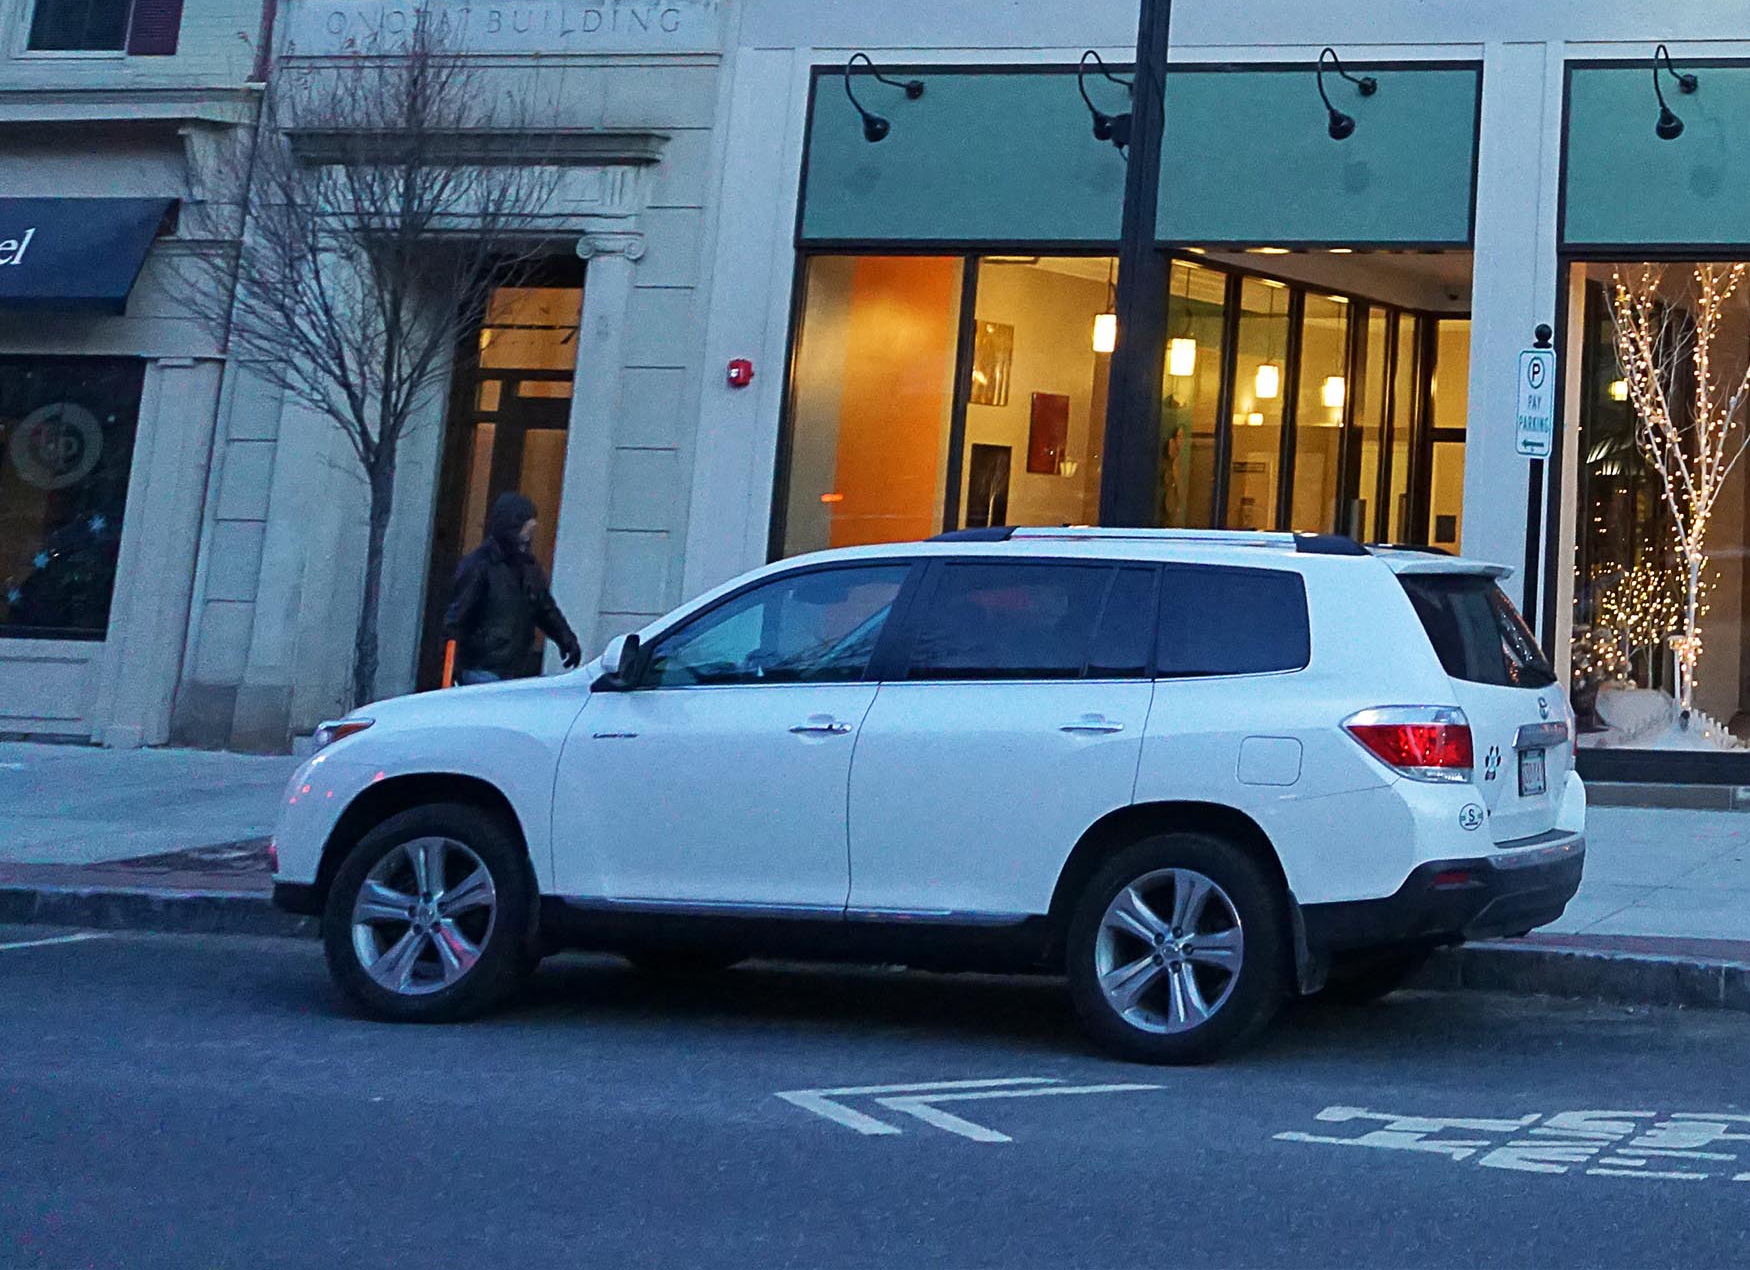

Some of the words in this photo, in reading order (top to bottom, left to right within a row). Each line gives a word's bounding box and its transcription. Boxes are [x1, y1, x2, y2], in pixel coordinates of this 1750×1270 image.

[486, 7, 680, 36] BUILDING
[0, 227, 36, 265] el
[1532, 362, 1541, 382] P
[1527, 394, 1542, 411] PAY
[1518, 414, 1549, 434] PARKING
[1468, 808, 1476, 823] S
